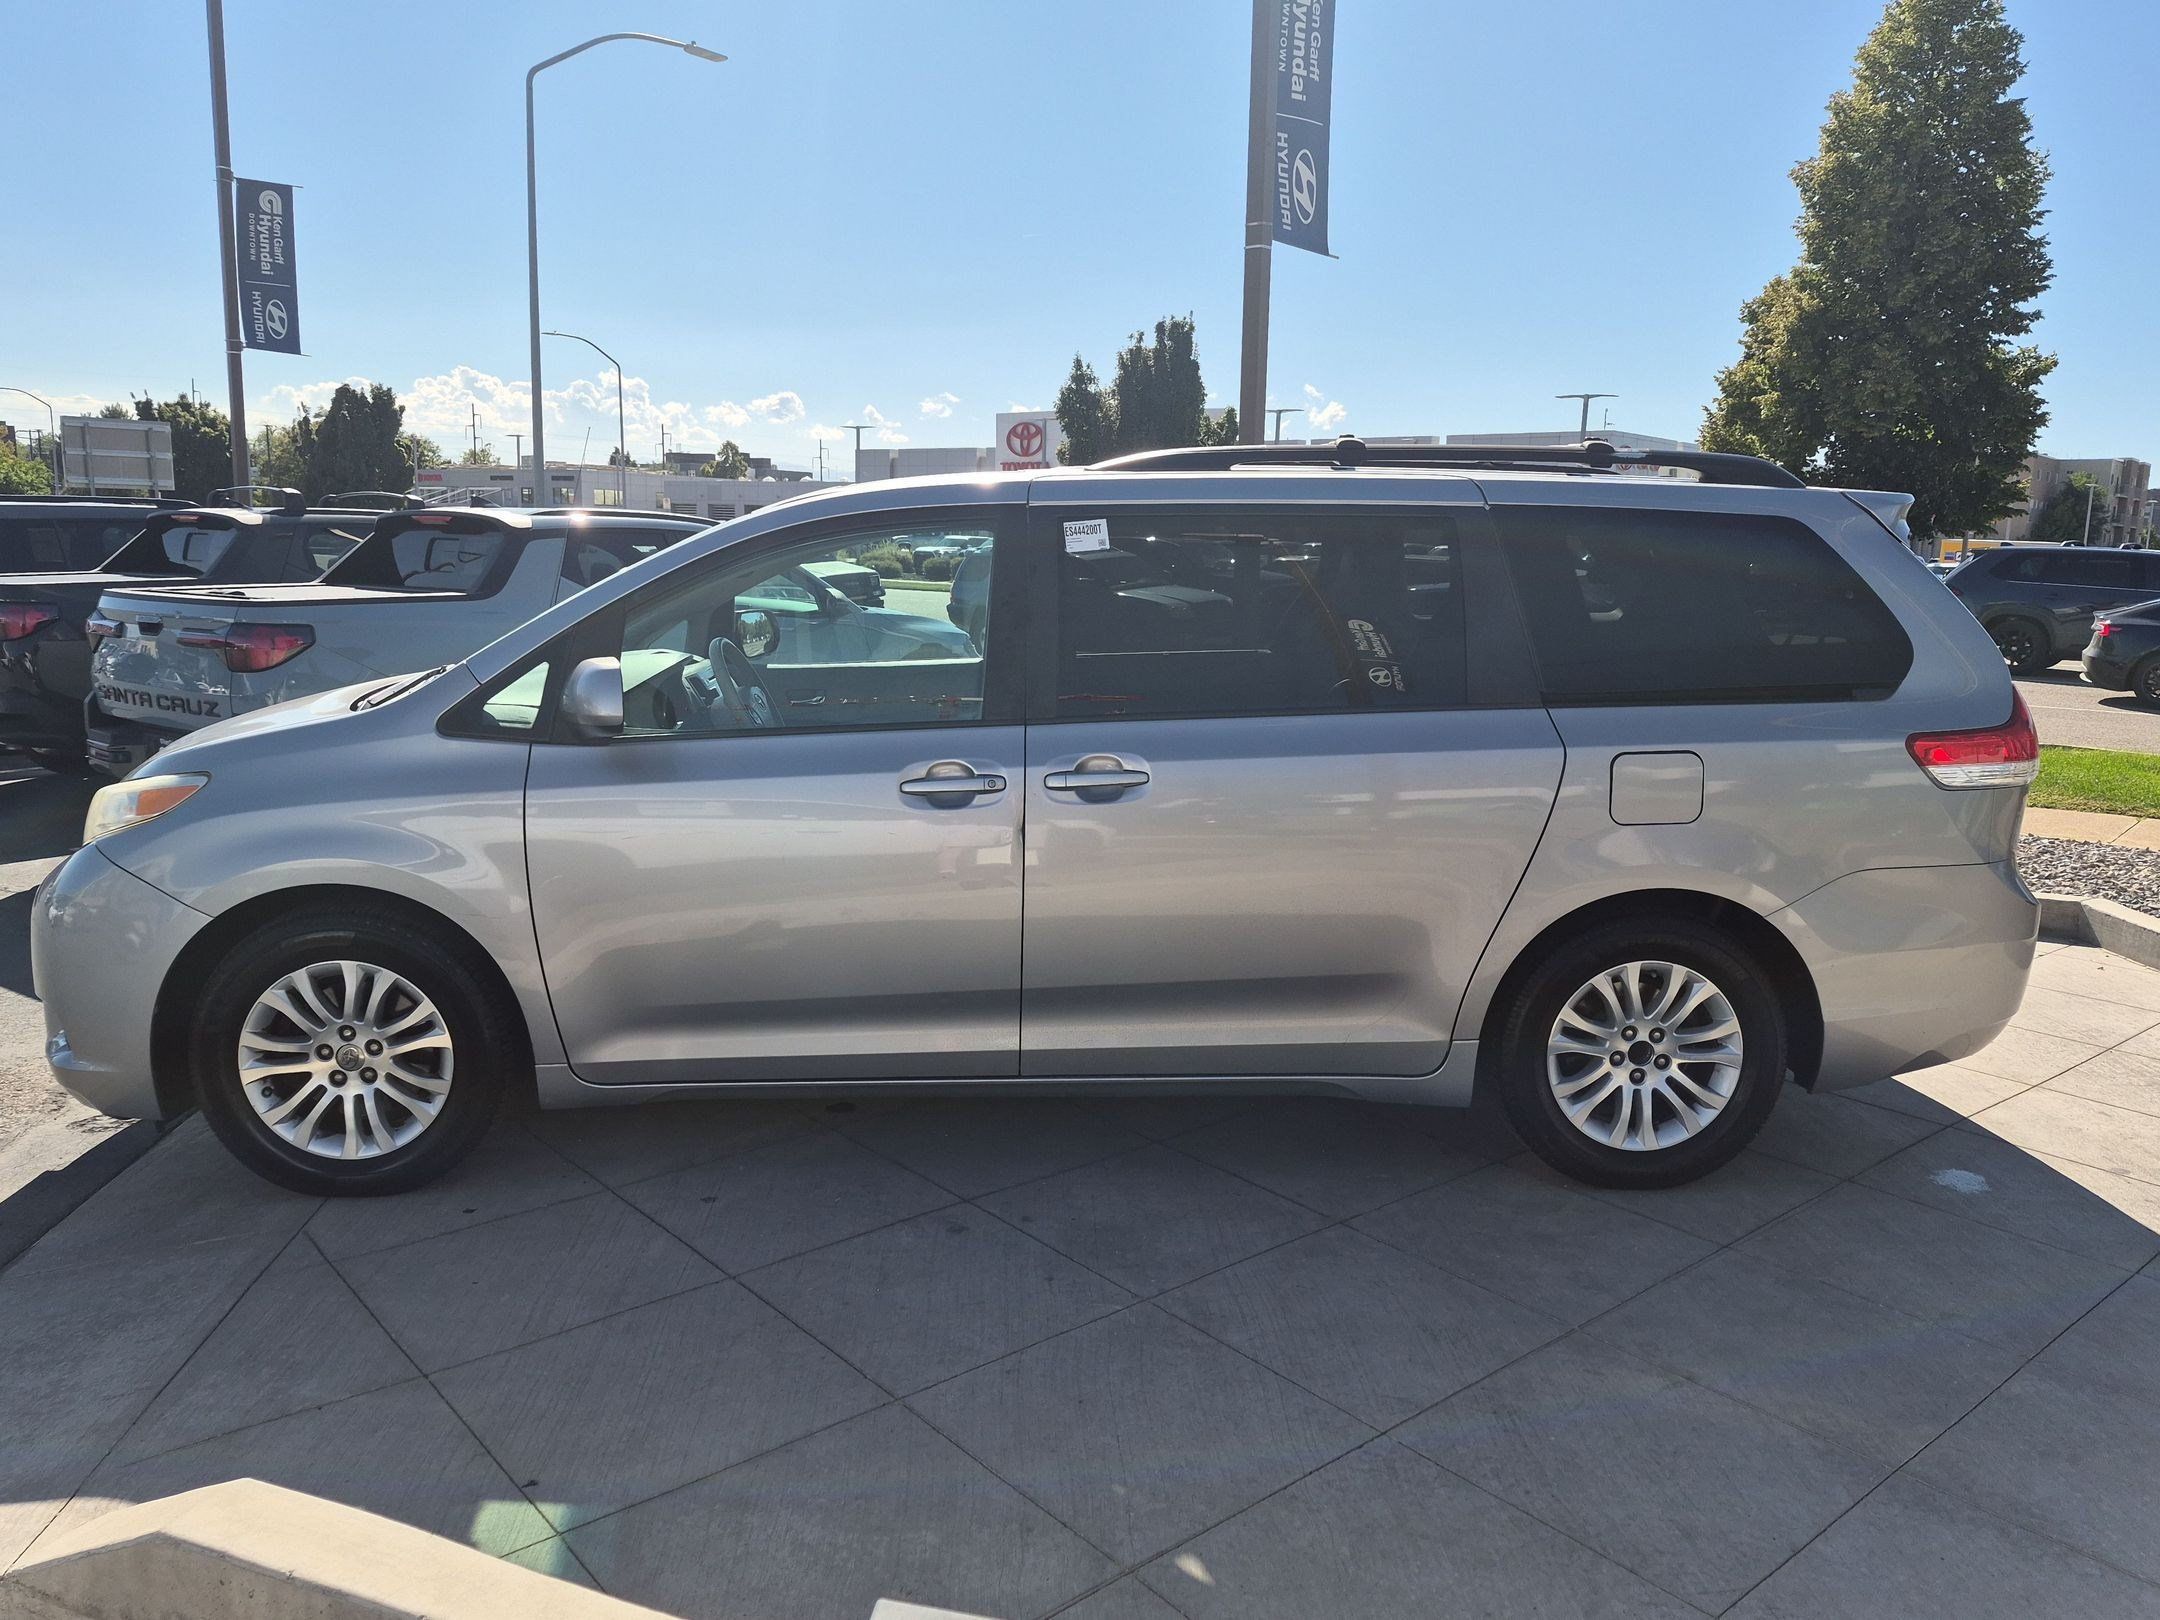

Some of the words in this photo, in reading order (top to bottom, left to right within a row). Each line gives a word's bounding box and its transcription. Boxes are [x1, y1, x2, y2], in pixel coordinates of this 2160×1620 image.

[1279, 0, 1290, 72] WNTOWN
[1309, 31, 1321, 81] Garff
[1276, 132, 1292, 231] HYUNDAI
[248, 213, 256, 261] DOWNTOWN
[257, 214, 274, 275] Hyundai
[272, 216, 283, 237] Ken
[274, 239, 285, 265] Garff
[252, 291, 266, 343] HYUNDAI
[98, 684, 153, 708] SANTA
[156, 694, 222, 718] CRUZ
